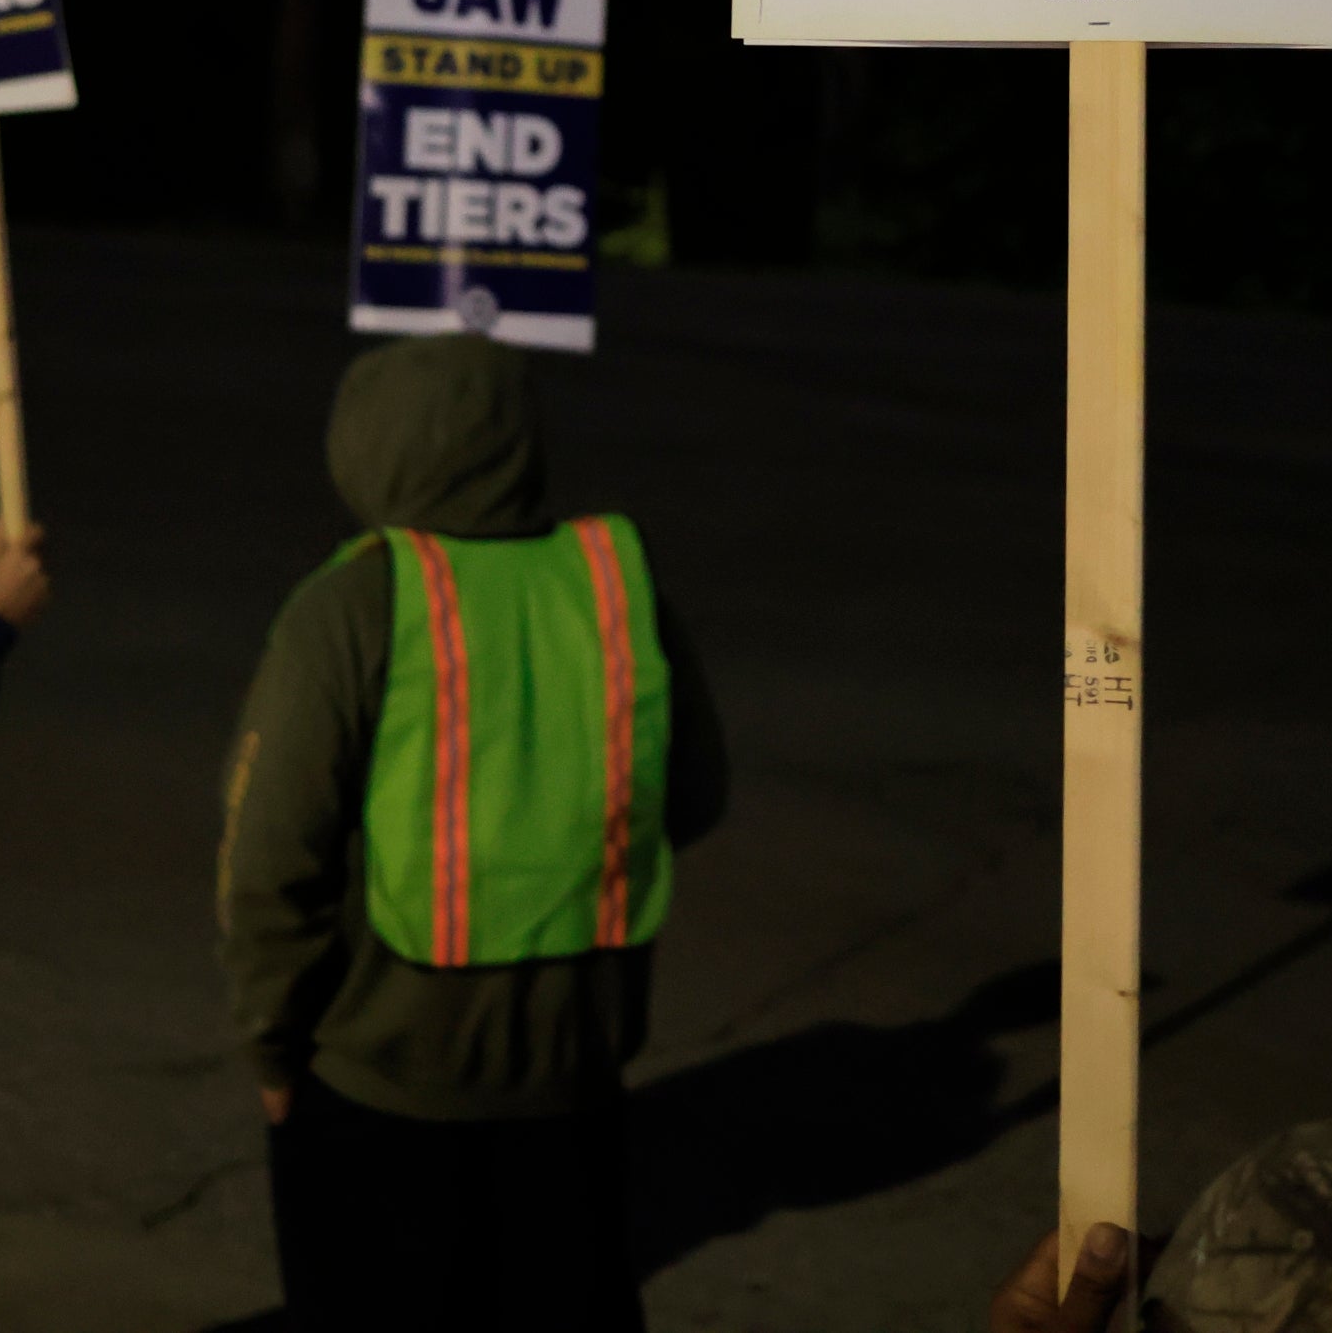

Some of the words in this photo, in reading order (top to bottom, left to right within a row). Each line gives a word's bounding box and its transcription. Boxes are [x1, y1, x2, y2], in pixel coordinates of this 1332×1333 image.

[383, 44, 522, 82] STAND
[536, 55, 590, 84] UP
[402, 106, 564, 178] END
[367, 175, 590, 250] TIERS
[1104, 676, 1133, 710] HT
